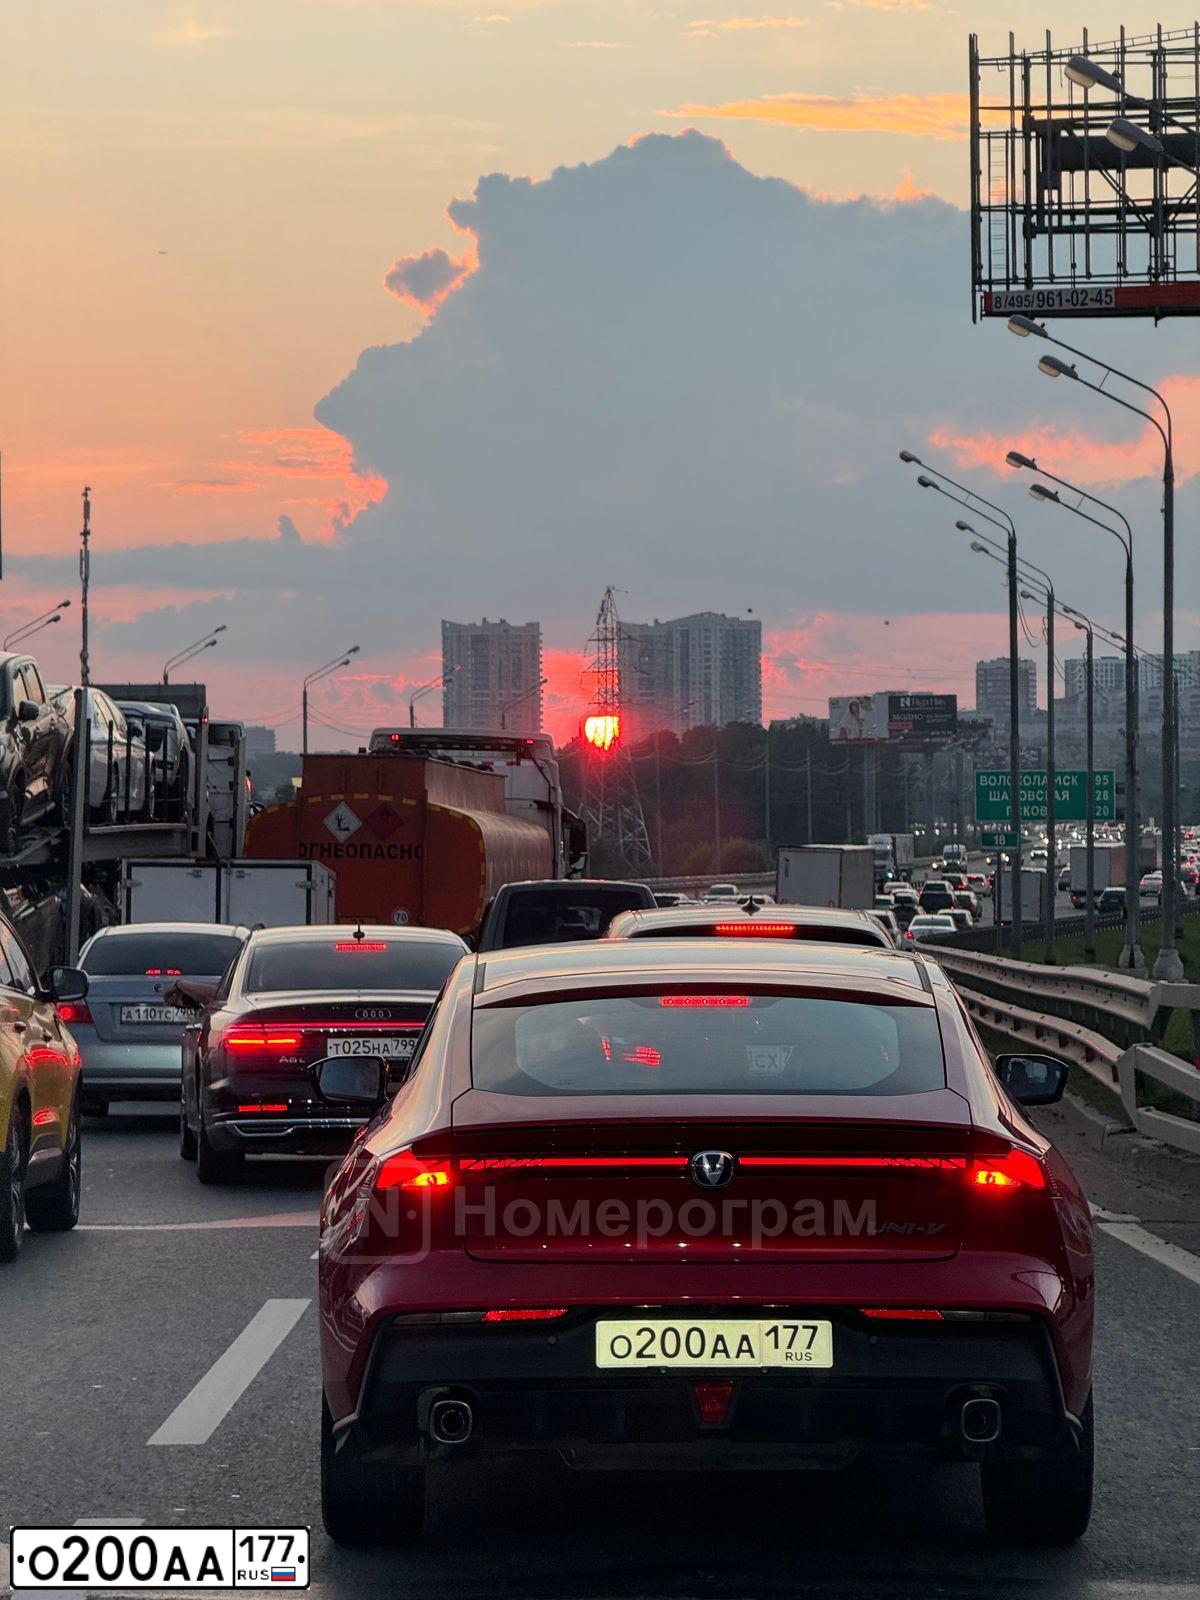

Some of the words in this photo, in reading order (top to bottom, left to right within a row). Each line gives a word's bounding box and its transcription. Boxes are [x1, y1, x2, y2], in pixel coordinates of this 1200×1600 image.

[980, 775, 1078, 786] ВОЛООЛАМСК
[1095, 774, 1109, 785] 95
[989, 790, 1070, 801] ШАОВСАЯ
[1006, 805, 1048, 816] ПКОВ
[993, 835, 1006, 845] 18
[298, 842, 424, 859] ОГНЕОПАСНО
[395, 911, 407, 921] 70
[335, 1040, 390, 1055] Т025НА
[393, 1040, 415, 1051] 799
[610, 1326, 756, 1359] О200АА
[764, 1325, 819, 1350] 177
[785, 1352, 813, 1361] RUS
